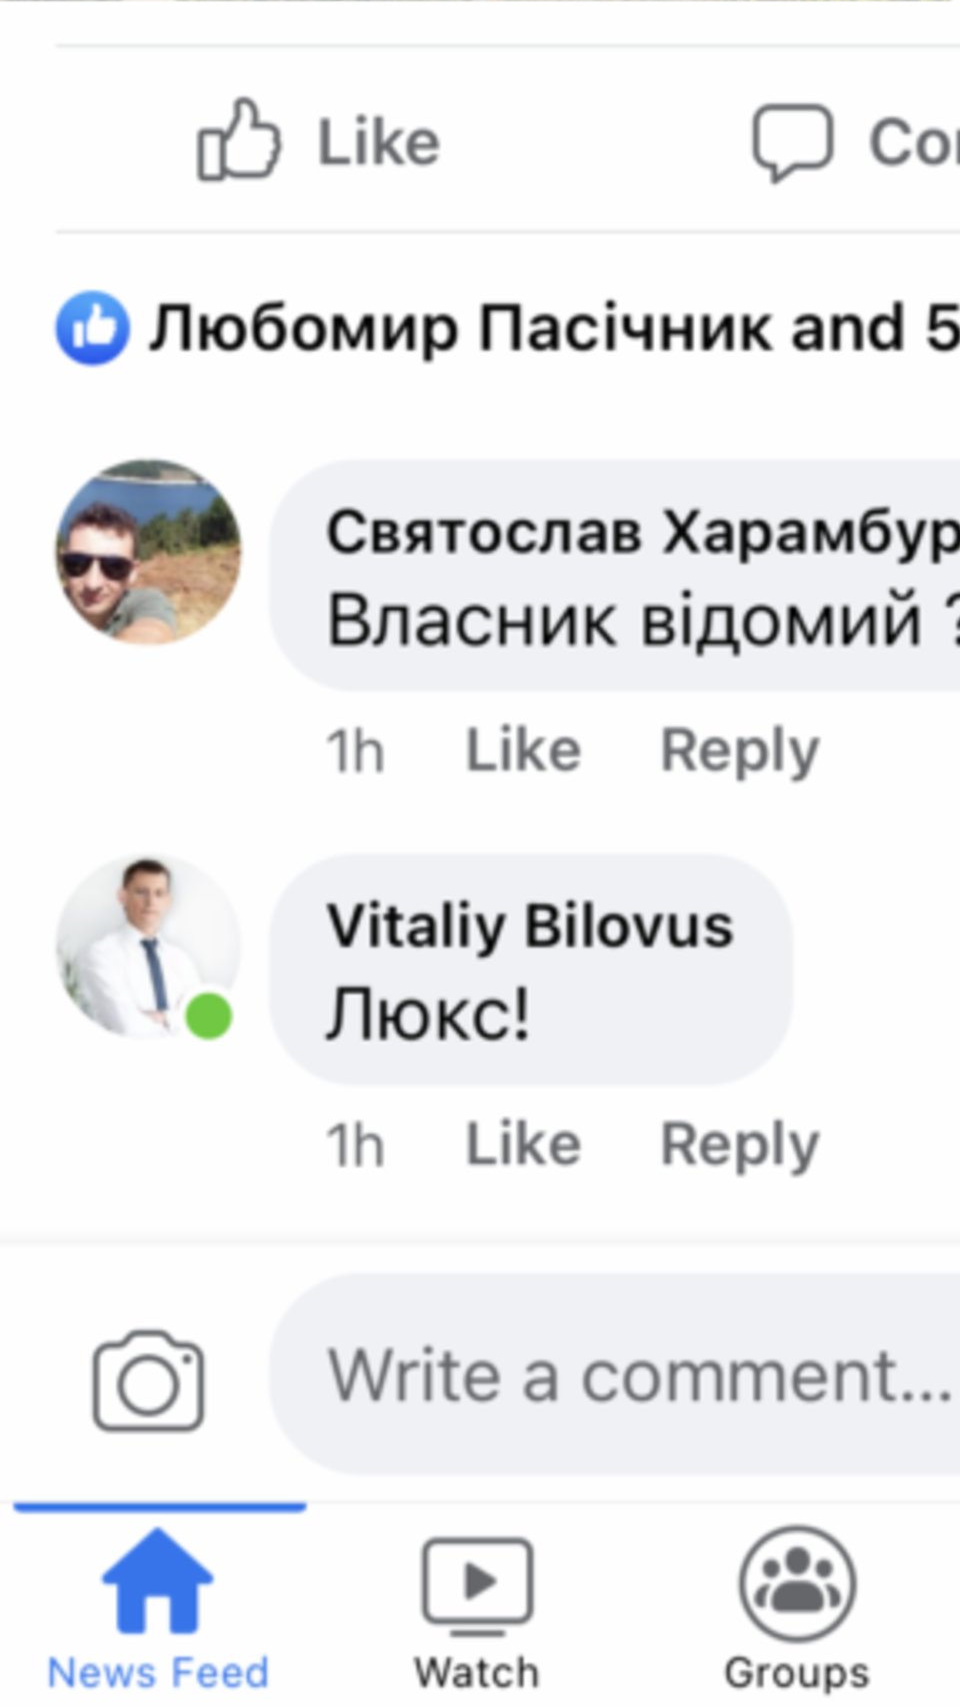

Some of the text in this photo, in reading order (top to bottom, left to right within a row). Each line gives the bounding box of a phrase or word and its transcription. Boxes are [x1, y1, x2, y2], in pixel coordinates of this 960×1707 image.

[319, 116, 440, 167] Like
[148, 300, 459, 364] Любомир
[480, 299, 774, 352] Пасічник
[791, 300, 904, 352] and
[326, 507, 643, 555] Святослав
[329, 590, 618, 648] Власник
[643, 587, 921, 658] відомий
[327, 726, 384, 773] 1h
[467, 723, 581, 773] Like
[662, 724, 820, 783] Reply
[326, 899, 734, 960] Vitaliy Bilovus
[324, 985, 528, 1042] Люкс!
[327, 1120, 384, 1167] 1h
[467, 1117, 581, 1167] Like
[662, 1119, 820, 1177] Reply
[328, 1345, 951, 1403] Write a comment...
[49, 1656, 268, 1688] News Feed
[413, 1655, 539, 1689] Watch
[724, 1655, 870, 1696] Groups
